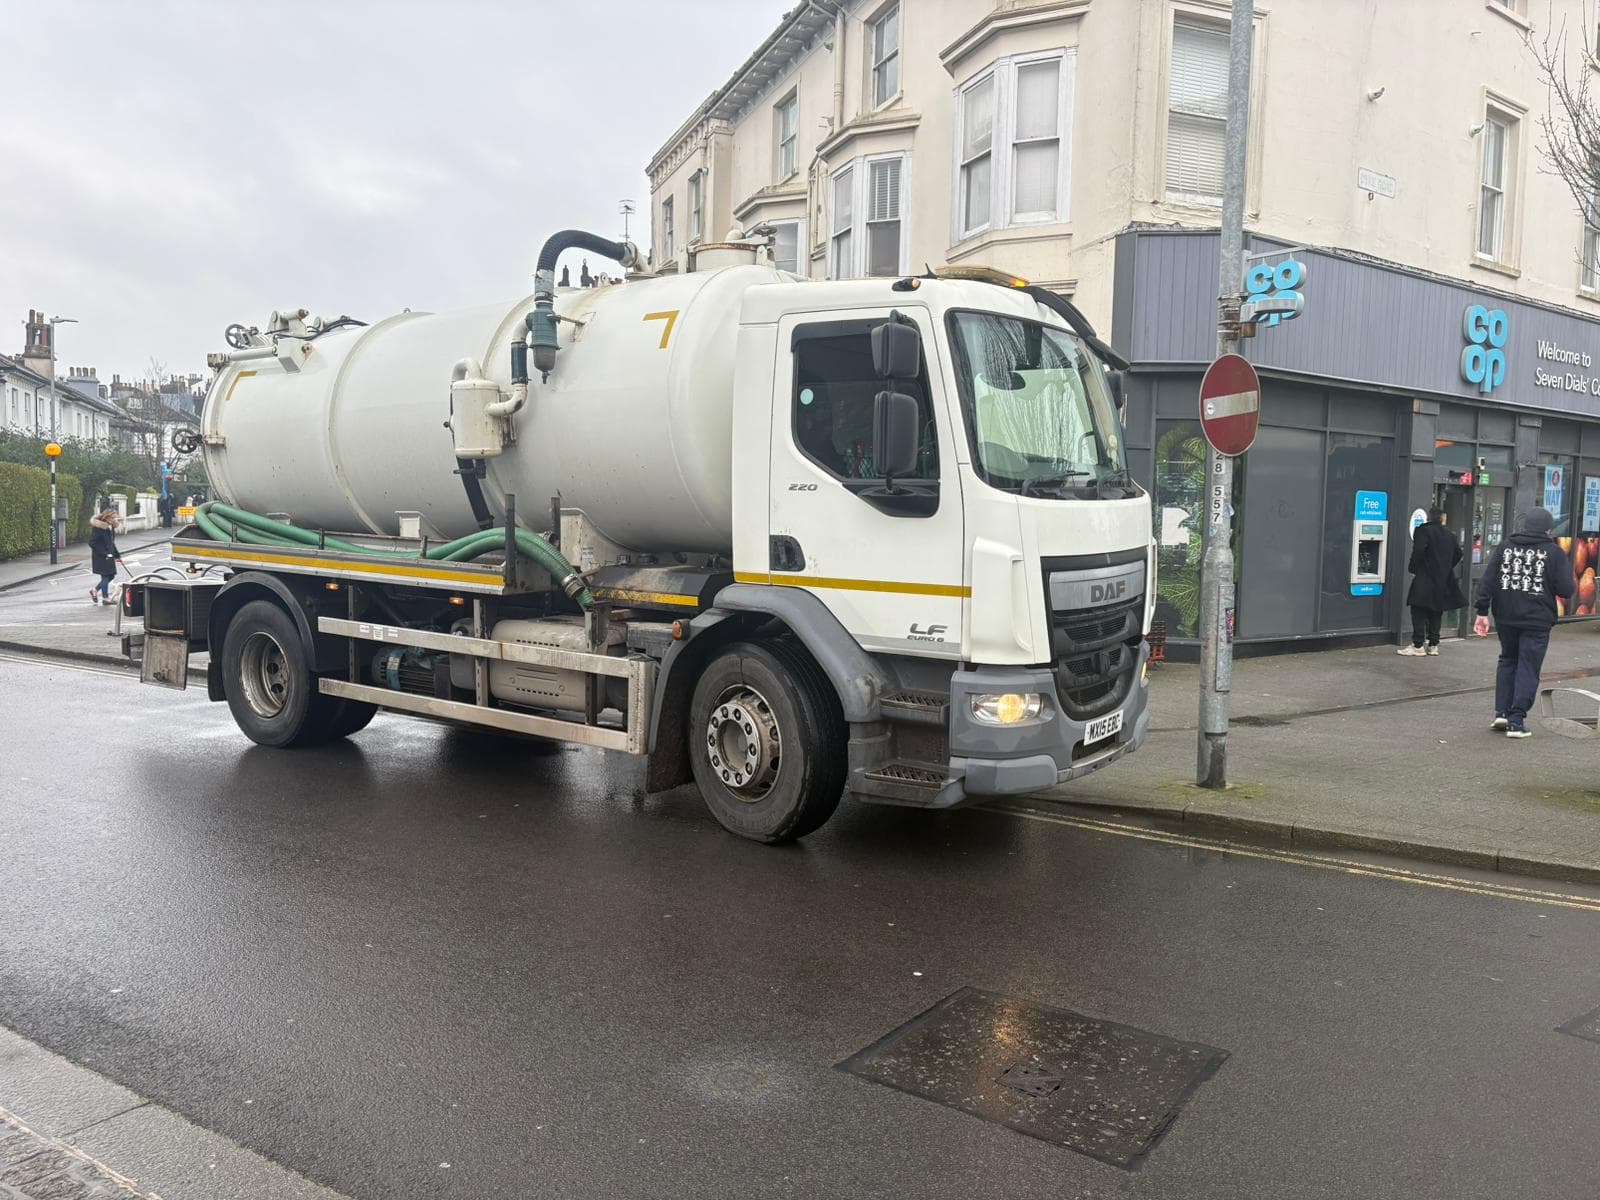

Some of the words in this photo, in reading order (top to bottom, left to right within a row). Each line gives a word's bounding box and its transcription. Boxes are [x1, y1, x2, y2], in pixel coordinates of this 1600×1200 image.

[1464, 304, 1508, 348] co
[1537, 339, 1580, 366] Welcome
[1581, 351, 1592, 368] to
[1461, 344, 1505, 393] op
[1535, 367, 1564, 389] Seven
[1565, 373, 1590, 393] Dials'
[788, 483, 818, 491] 220
[1545, 489, 1561, 506] WAY
[1363, 497, 1379, 509] Free
[1090, 580, 1126, 603] DAF
[907, 634, 936, 642] EURO
[910, 623, 948, 635] LF
[1089, 719, 1107, 741] MX15
